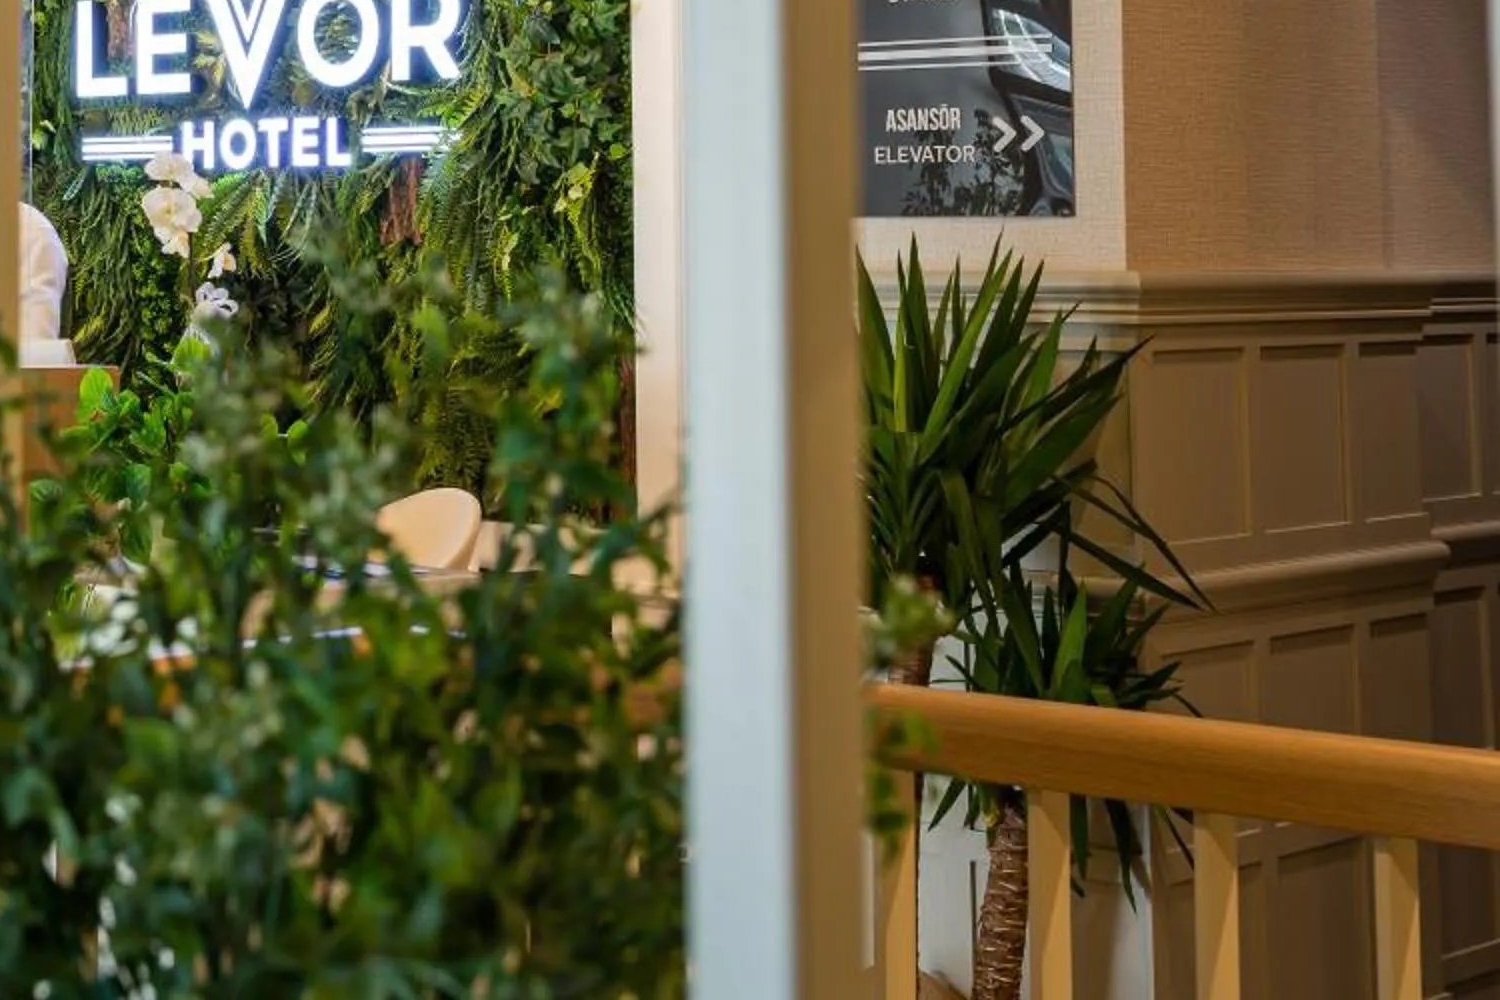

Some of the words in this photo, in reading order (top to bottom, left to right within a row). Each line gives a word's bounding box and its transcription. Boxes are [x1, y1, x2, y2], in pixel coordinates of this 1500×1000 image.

[885, 104, 961, 132] ASANSÖR
[181, 116, 353, 170] HOTEL
[874, 145, 977, 165] ELEVATOR
